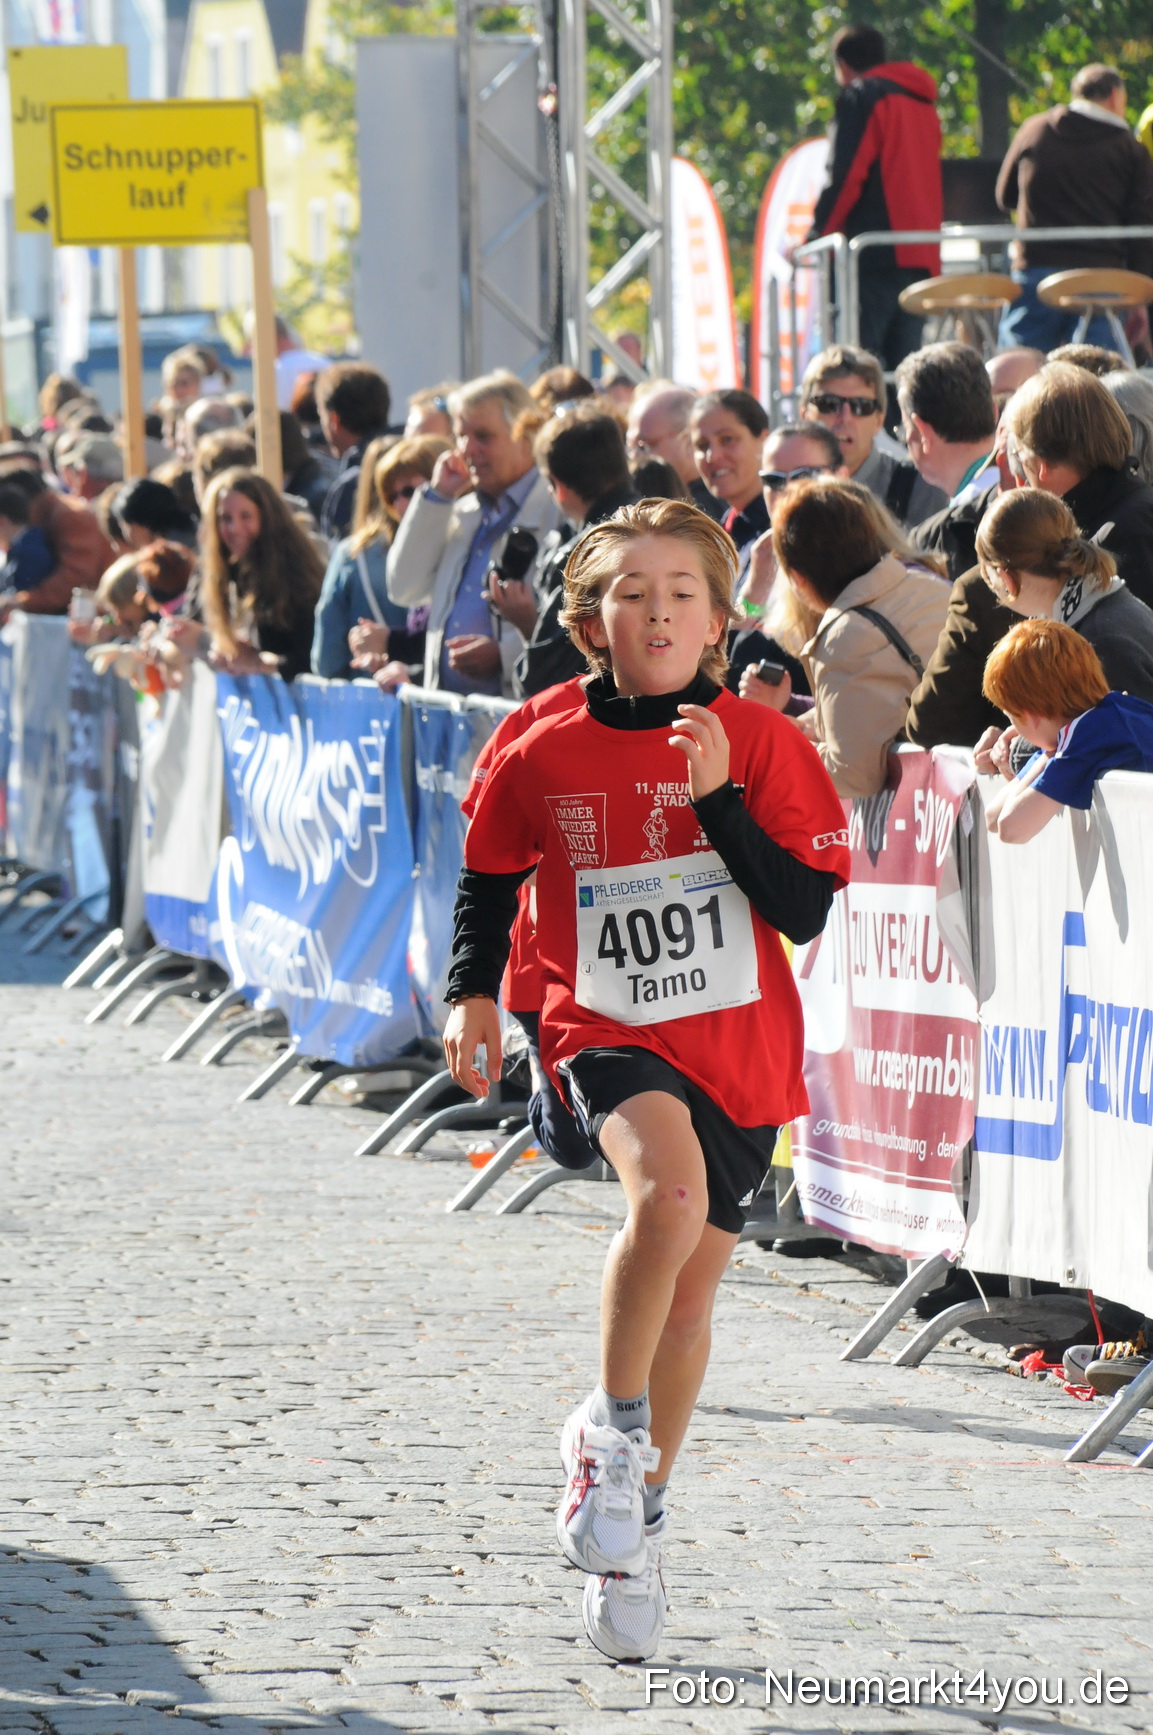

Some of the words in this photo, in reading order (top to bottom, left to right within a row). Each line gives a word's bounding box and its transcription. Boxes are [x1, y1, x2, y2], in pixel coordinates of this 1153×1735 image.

[14, 97, 47, 124] Ju
[65, 144, 247, 174] Schnupper-
[129, 181, 187, 209] lauf
[635, 783, 654, 794] 11.
[555, 806, 594, 819] IMMER
[558, 820, 598, 833] WIEDER
[564, 833, 596, 852] NEU
[570, 851, 600, 865] MARKT
[595, 877, 663, 898] PFLEIDERER
[595, 892, 665, 908] AKTIENGESELLSCHAFT
[597, 894, 724, 969] 4091
[852, 911, 868, 977] ZU
[585, 964, 592, 974] J
[627, 968, 706, 1004] Tamo
